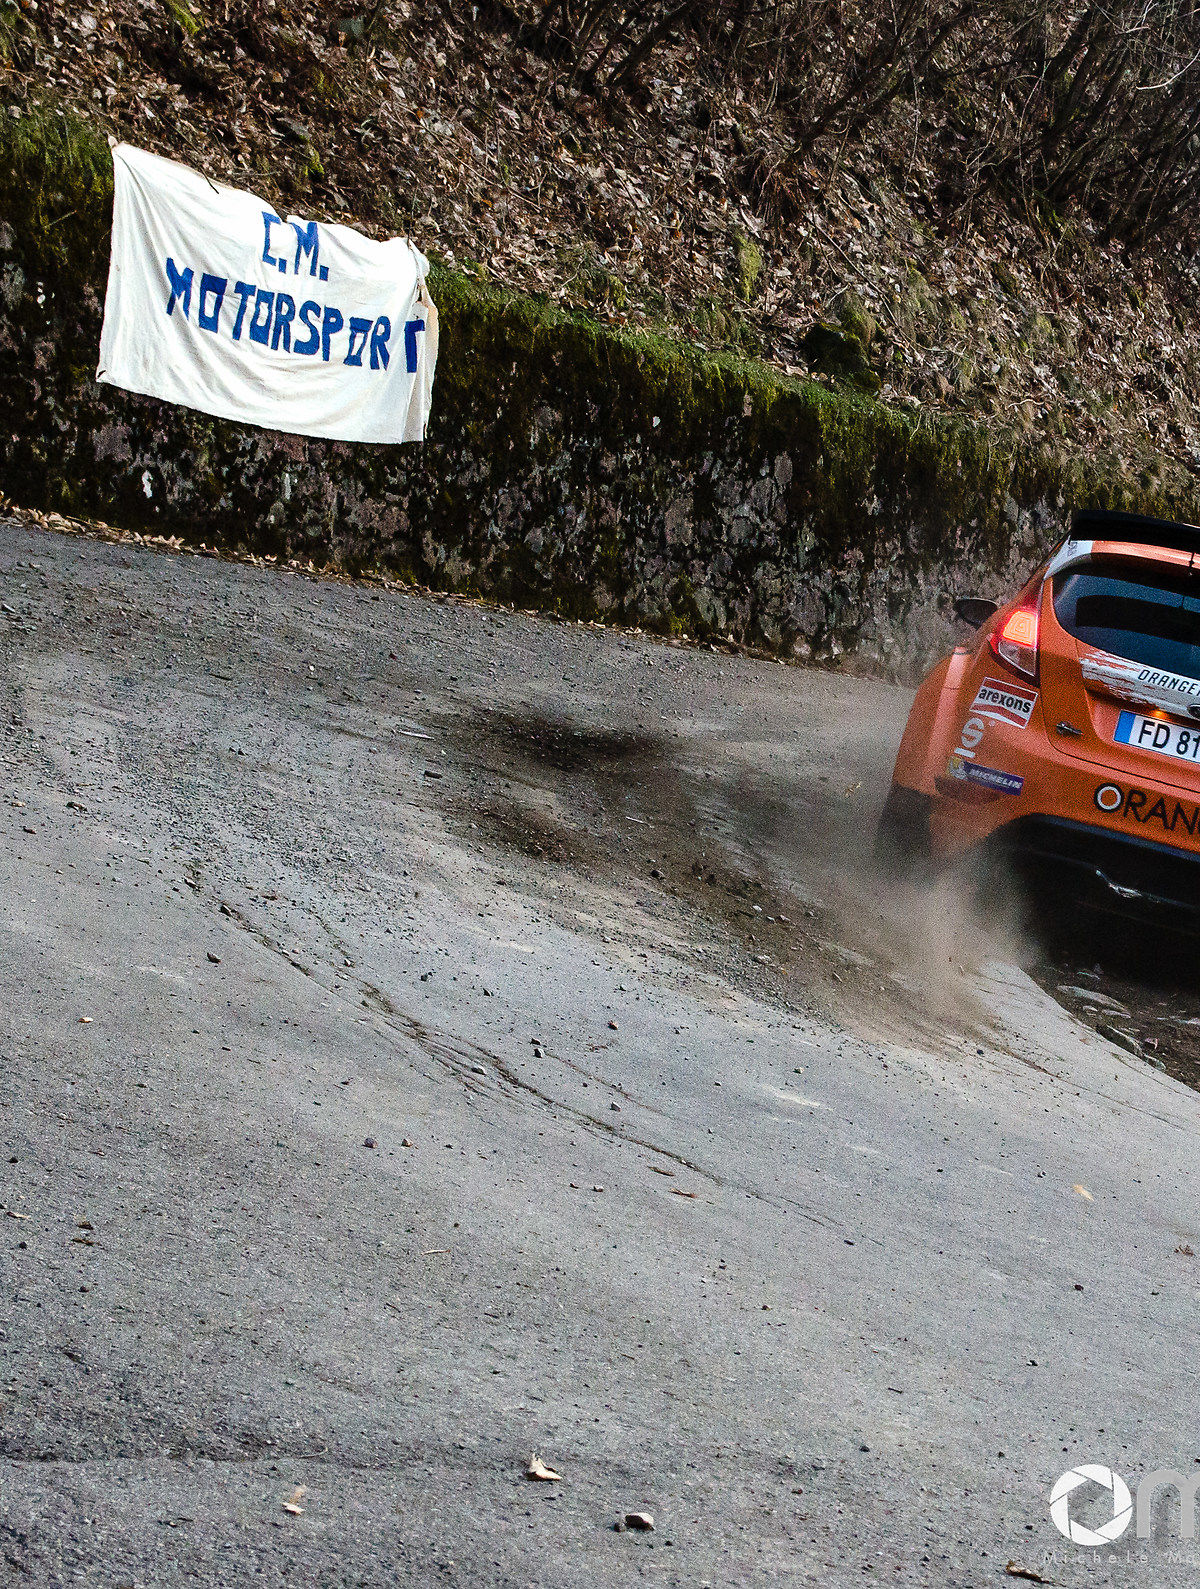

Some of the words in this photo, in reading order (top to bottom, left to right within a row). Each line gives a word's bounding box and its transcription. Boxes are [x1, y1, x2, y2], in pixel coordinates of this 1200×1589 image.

[262, 211, 330, 281] C.M.
[165, 257, 426, 374] MOTORSPORT
[978, 687, 1032, 714] arexons
[1137, 719, 1171, 749] FD
